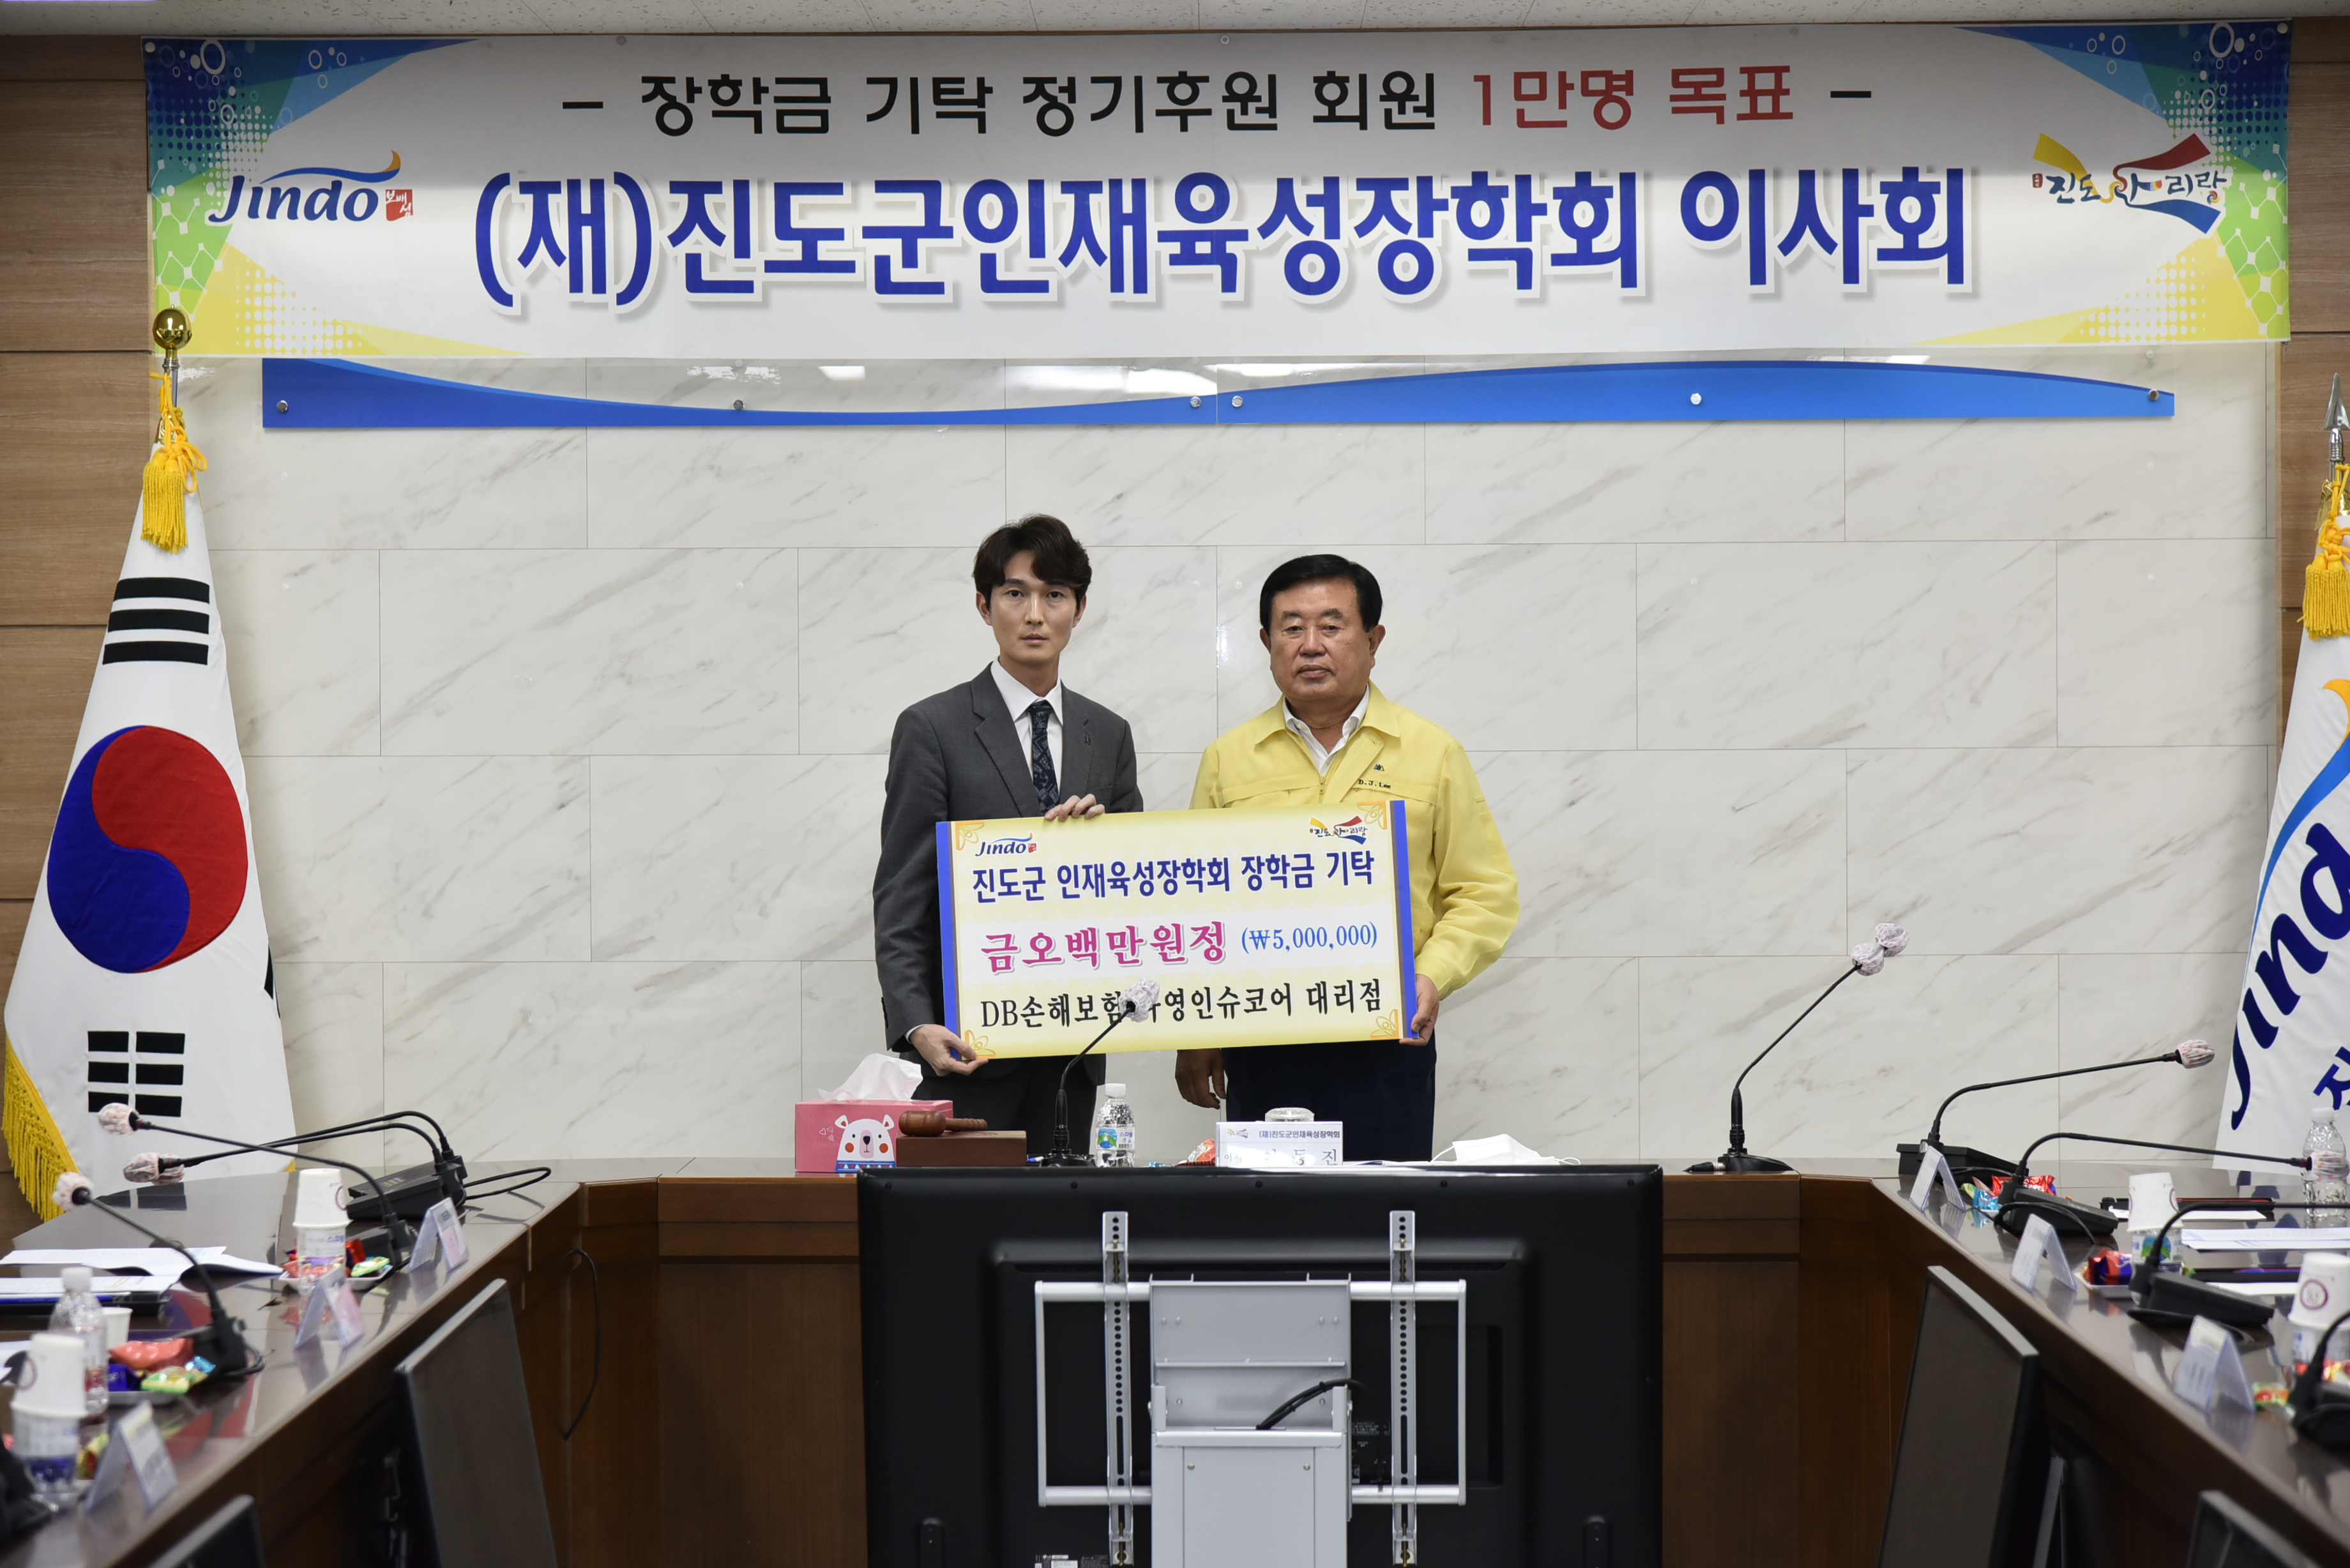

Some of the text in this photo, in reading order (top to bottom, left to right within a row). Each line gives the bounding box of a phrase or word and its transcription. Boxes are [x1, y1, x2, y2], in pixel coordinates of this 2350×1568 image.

[641, 74, 831, 137] 장학금
[866, 75, 994, 135] 기탁
[1022, 71, 1278, 137] 정기후원
[1312, 70, 1435, 130] 회원
[1474, 70, 1634, 130] 1만명
[1669, 65, 1793, 124] 목표
[208, 175, 379, 223] Jindo
[475, 167, 1964, 308] (재)진도군인재육성장학회 이사회
[974, 841, 1026, 857] Jindo
[973, 850, 1376, 903] 진도군 인재육성장학회 장학금 기탁
[982, 921, 1379, 973] 금오백만원정 (₩5,000,000)
[980, 991, 1123, 1029] DB손해보험
[1305, 978, 1381, 1015] 대리점
